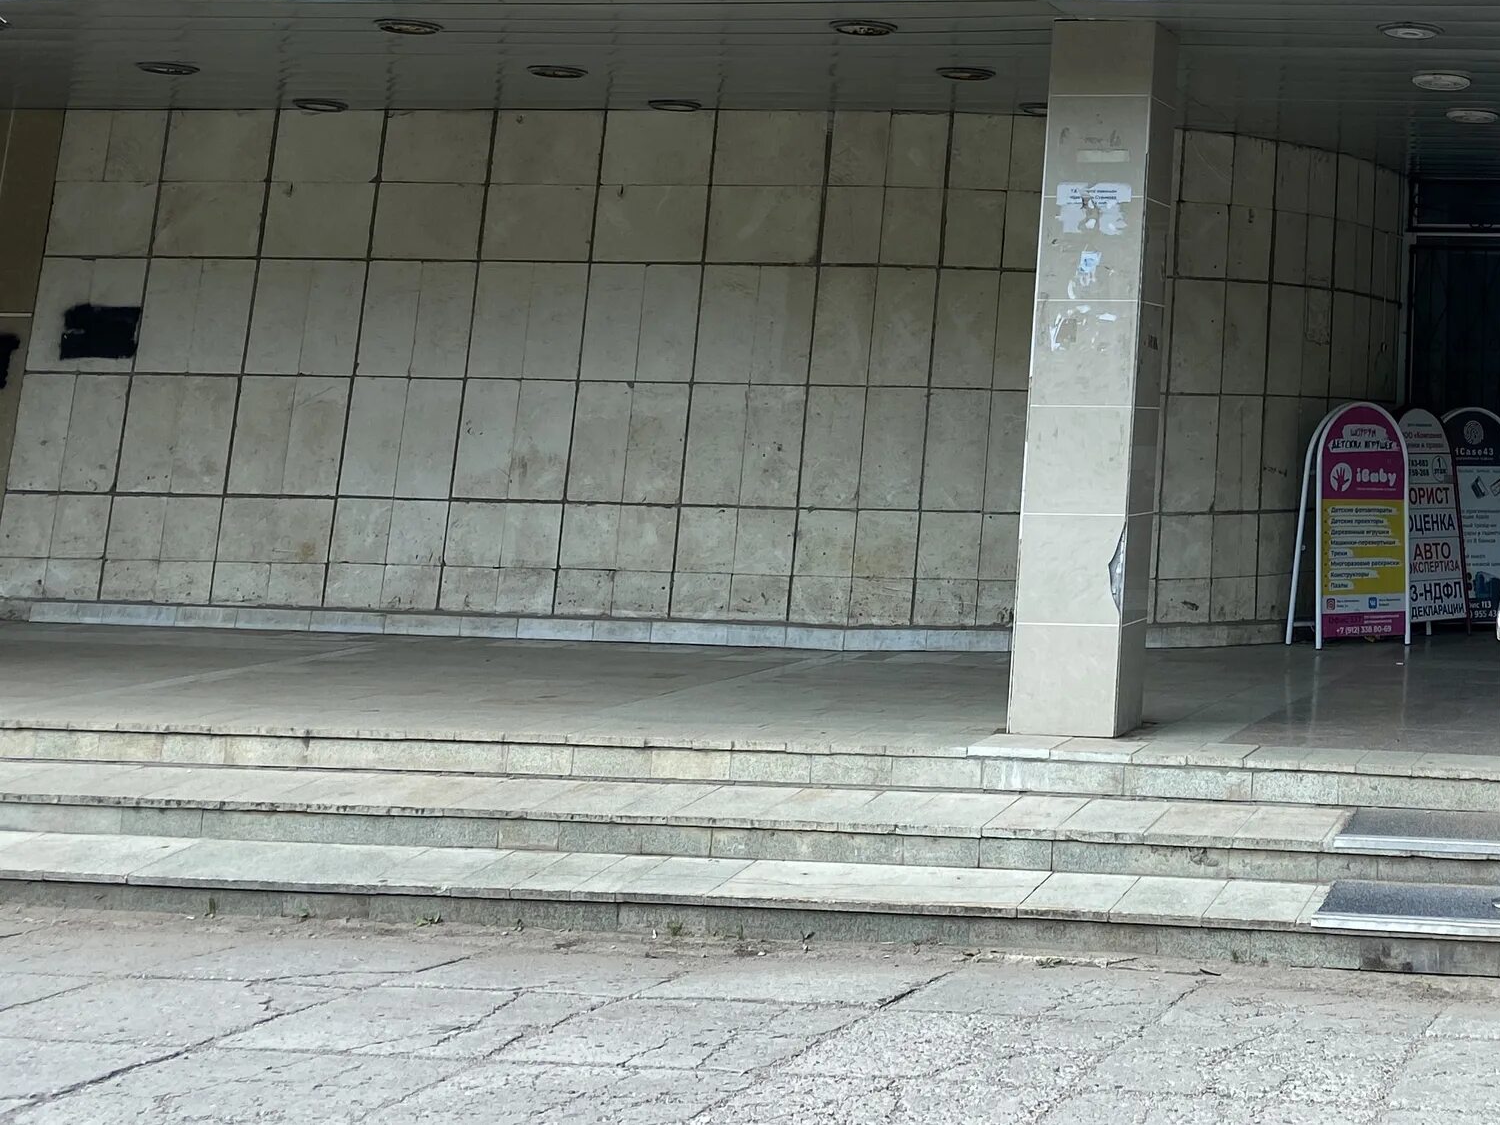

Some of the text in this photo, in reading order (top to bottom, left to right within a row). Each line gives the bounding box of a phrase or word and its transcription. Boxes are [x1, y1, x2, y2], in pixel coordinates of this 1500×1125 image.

[1454, 448, 1494, 456] iCase43
[1414, 542, 1451, 560] АВТО
[1409, 560, 1460, 574] КСПЕРТИЗА
[1482, 601, 1492, 609] 113
[1488, 610, 1497, 618] 43
